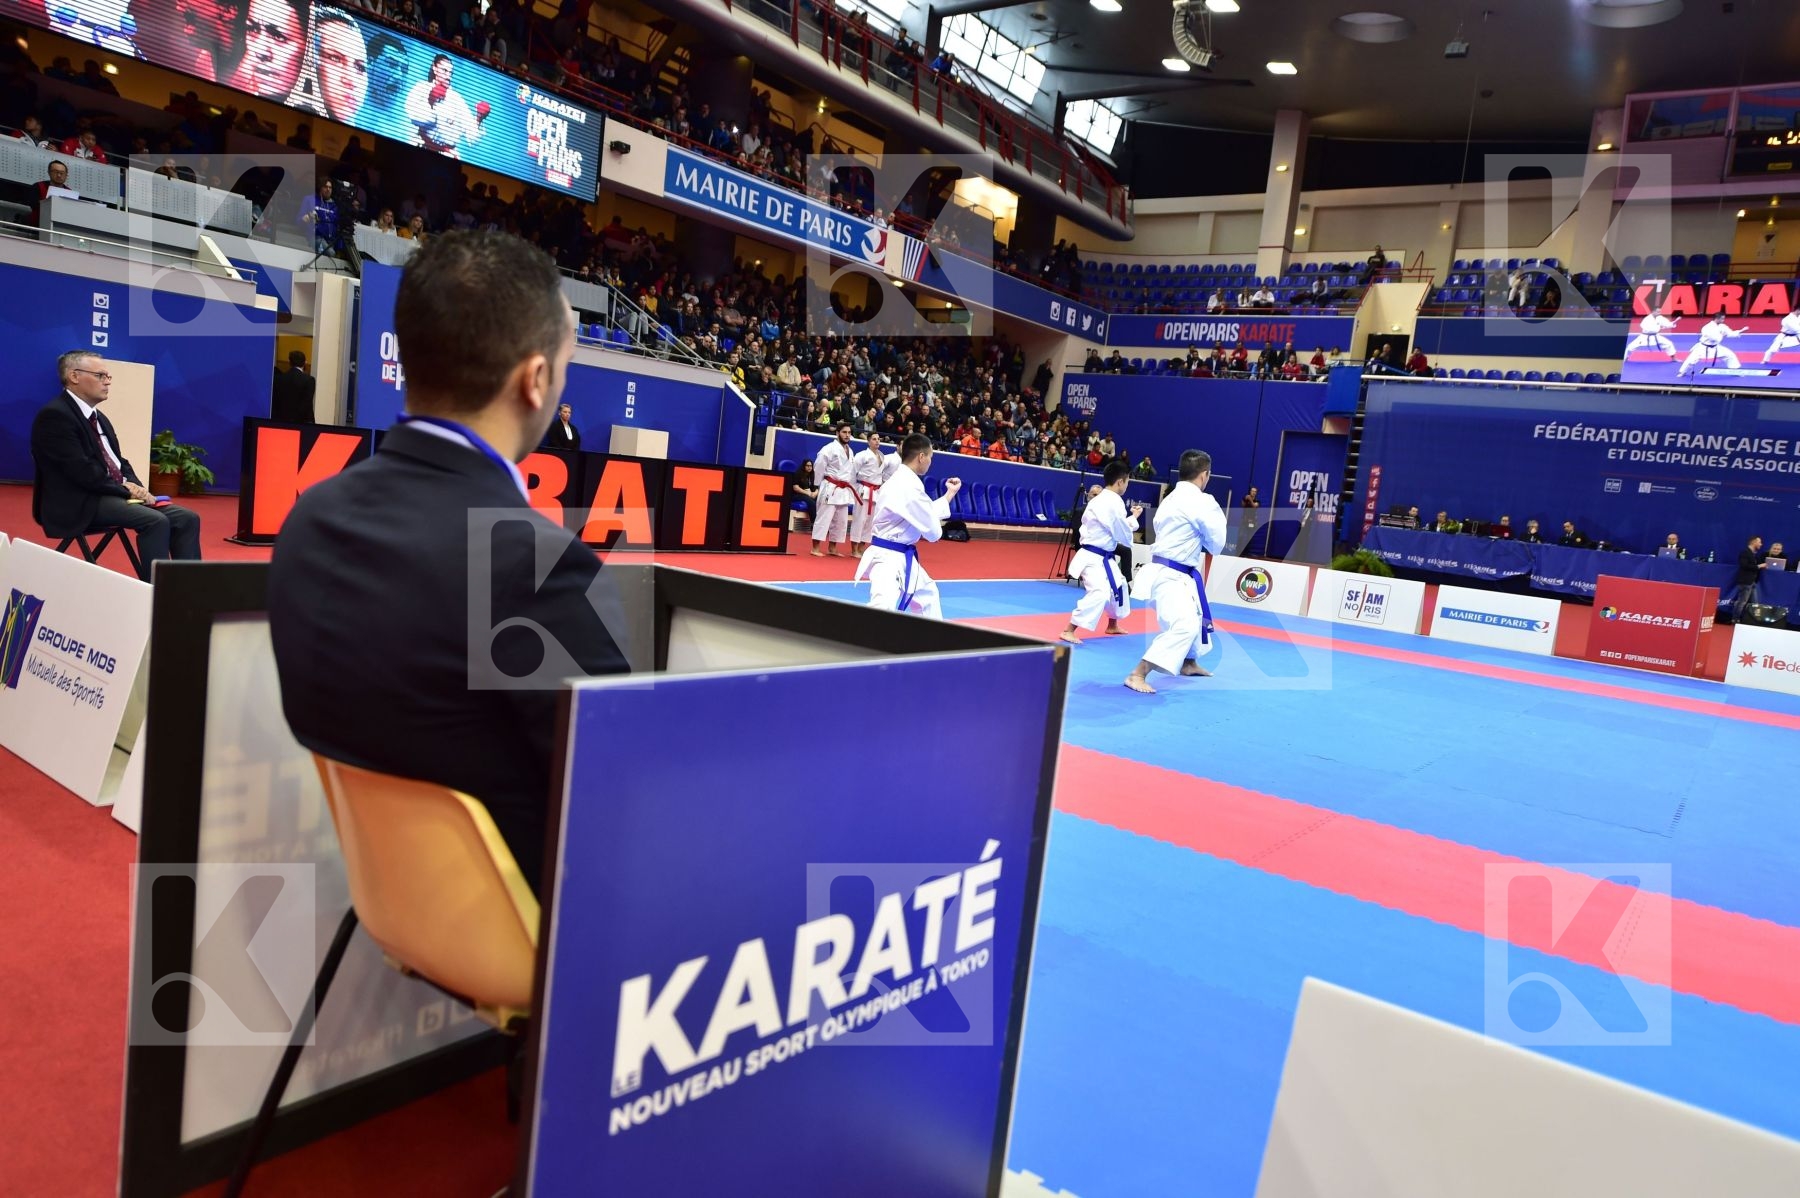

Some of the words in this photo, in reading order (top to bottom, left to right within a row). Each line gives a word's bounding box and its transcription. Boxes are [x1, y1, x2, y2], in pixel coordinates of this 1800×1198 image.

[527, 107, 568, 148] OPEN
[538, 140, 582, 178] PARIS
[675, 162, 760, 215] MAIRIE
[765, 195, 794, 227] DE
[799, 209, 852, 247] PARIS
[1155, 322, 1297, 344] #OPENPARISKARATE
[382, 363, 396, 381] DE
[1067, 383, 1090, 397] OPEN
[1072, 396, 1098, 409] PARIS
[1534, 421, 1659, 446] FÉDÉRATION
[1664, 432, 1789, 456] FRANÇAISE
[1607, 448, 1627, 460] ET
[1630, 449, 1729, 468] DISCIPLINES
[252, 427, 784, 548] KRATE
[1289, 470, 1329, 493] OPEN
[1289, 491, 1300, 503] DE
[1449, 610, 1483, 621] MAIRIE
[1485, 615, 1498, 624] DE
[1500, 618, 1528, 628] PARIS
[37, 625, 86, 660] GROUPE
[86, 647, 116, 674] MDS
[1624, 653, 1676, 668] #OPENPARISKARATE
[26, 653, 58, 685] Mutuelle
[55, 669, 72, 692] des
[71, 676, 105, 710] Sportifs
[611, 838, 1003, 1098] KARATÉ
[609, 1057, 741, 1136] NOUVEAU
[744, 1024, 819, 1076] SPORT
[820, 976, 924, 1041] OLYMPIQUE
[924, 967, 938, 995] À
[940, 948, 991, 986] TOKYO
